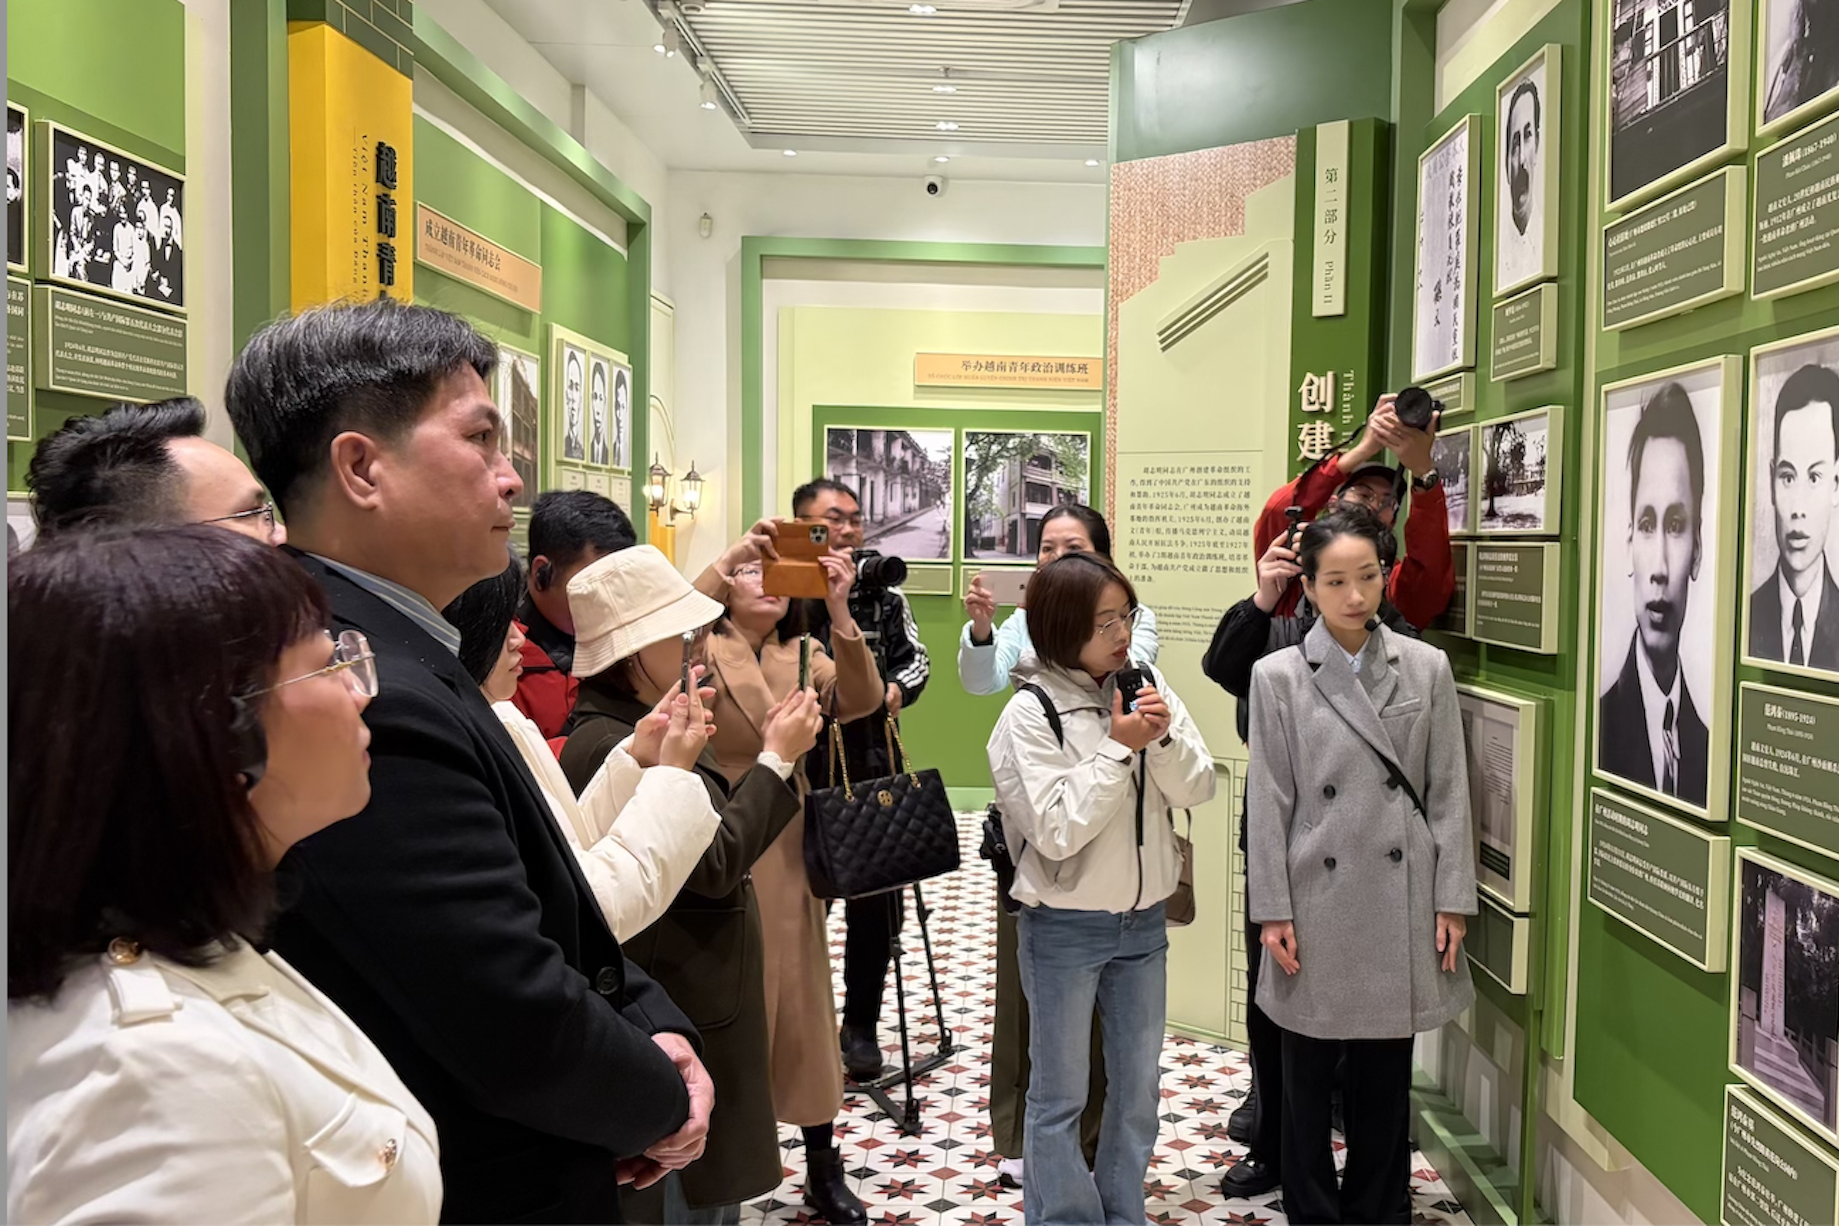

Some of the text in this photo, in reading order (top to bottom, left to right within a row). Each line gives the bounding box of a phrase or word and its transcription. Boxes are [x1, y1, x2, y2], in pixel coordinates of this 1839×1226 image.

[361, 183, 369, 225] Nam
[375, 141, 397, 300] 越南青
[1324, 167, 1339, 246] 第二部分
[424, 218, 501, 272] 成立越南青年革命同志会
[1323, 260, 1335, 304] Phần II
[961, 360, 1089, 375] 举办越南青年政治训练班
[1297, 370, 1336, 461] 创建
[1341, 369, 1355, 425] Thành
